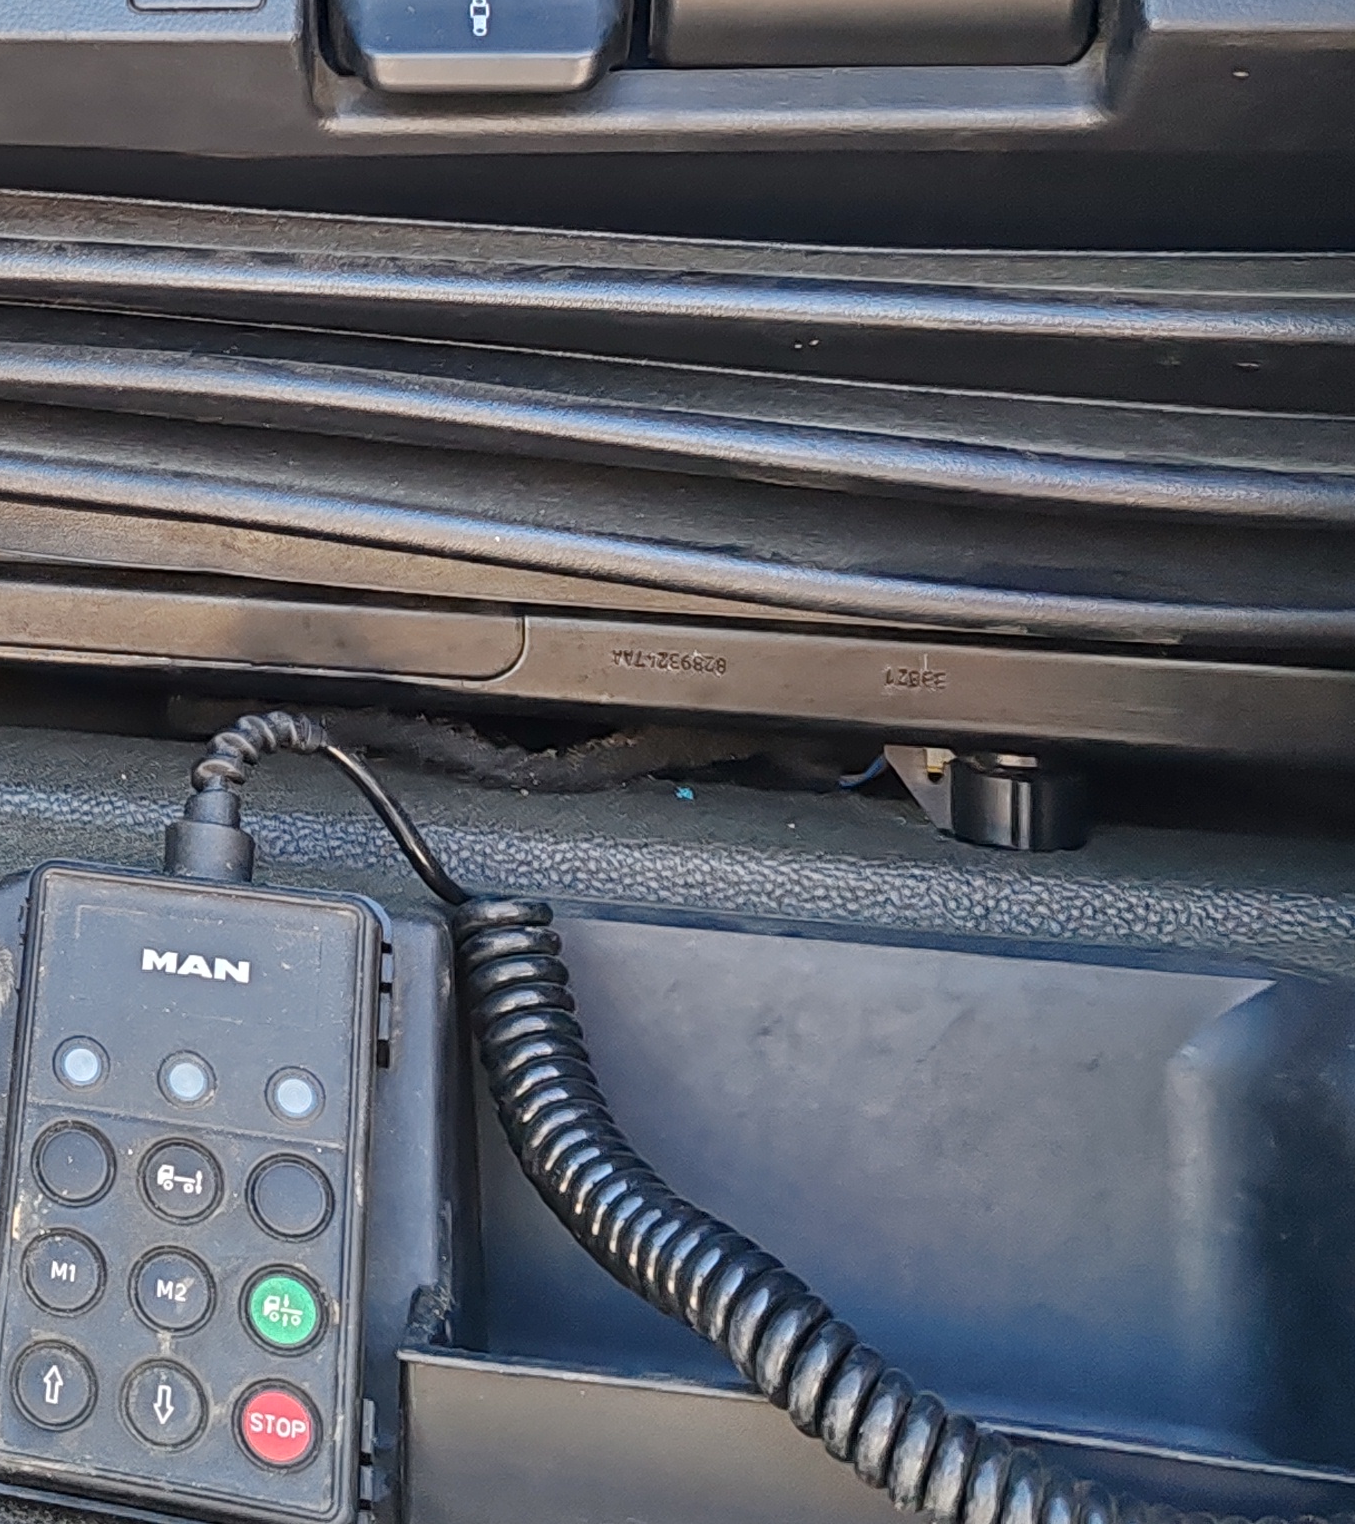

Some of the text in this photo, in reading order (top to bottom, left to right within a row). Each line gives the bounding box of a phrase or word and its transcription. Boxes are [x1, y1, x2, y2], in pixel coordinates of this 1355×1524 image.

[142, 948, 250, 983] MAN
[50, 1260, 76, 1282] M1
[156, 1278, 188, 1302] M2
[250, 1412, 306, 1439] STOP
